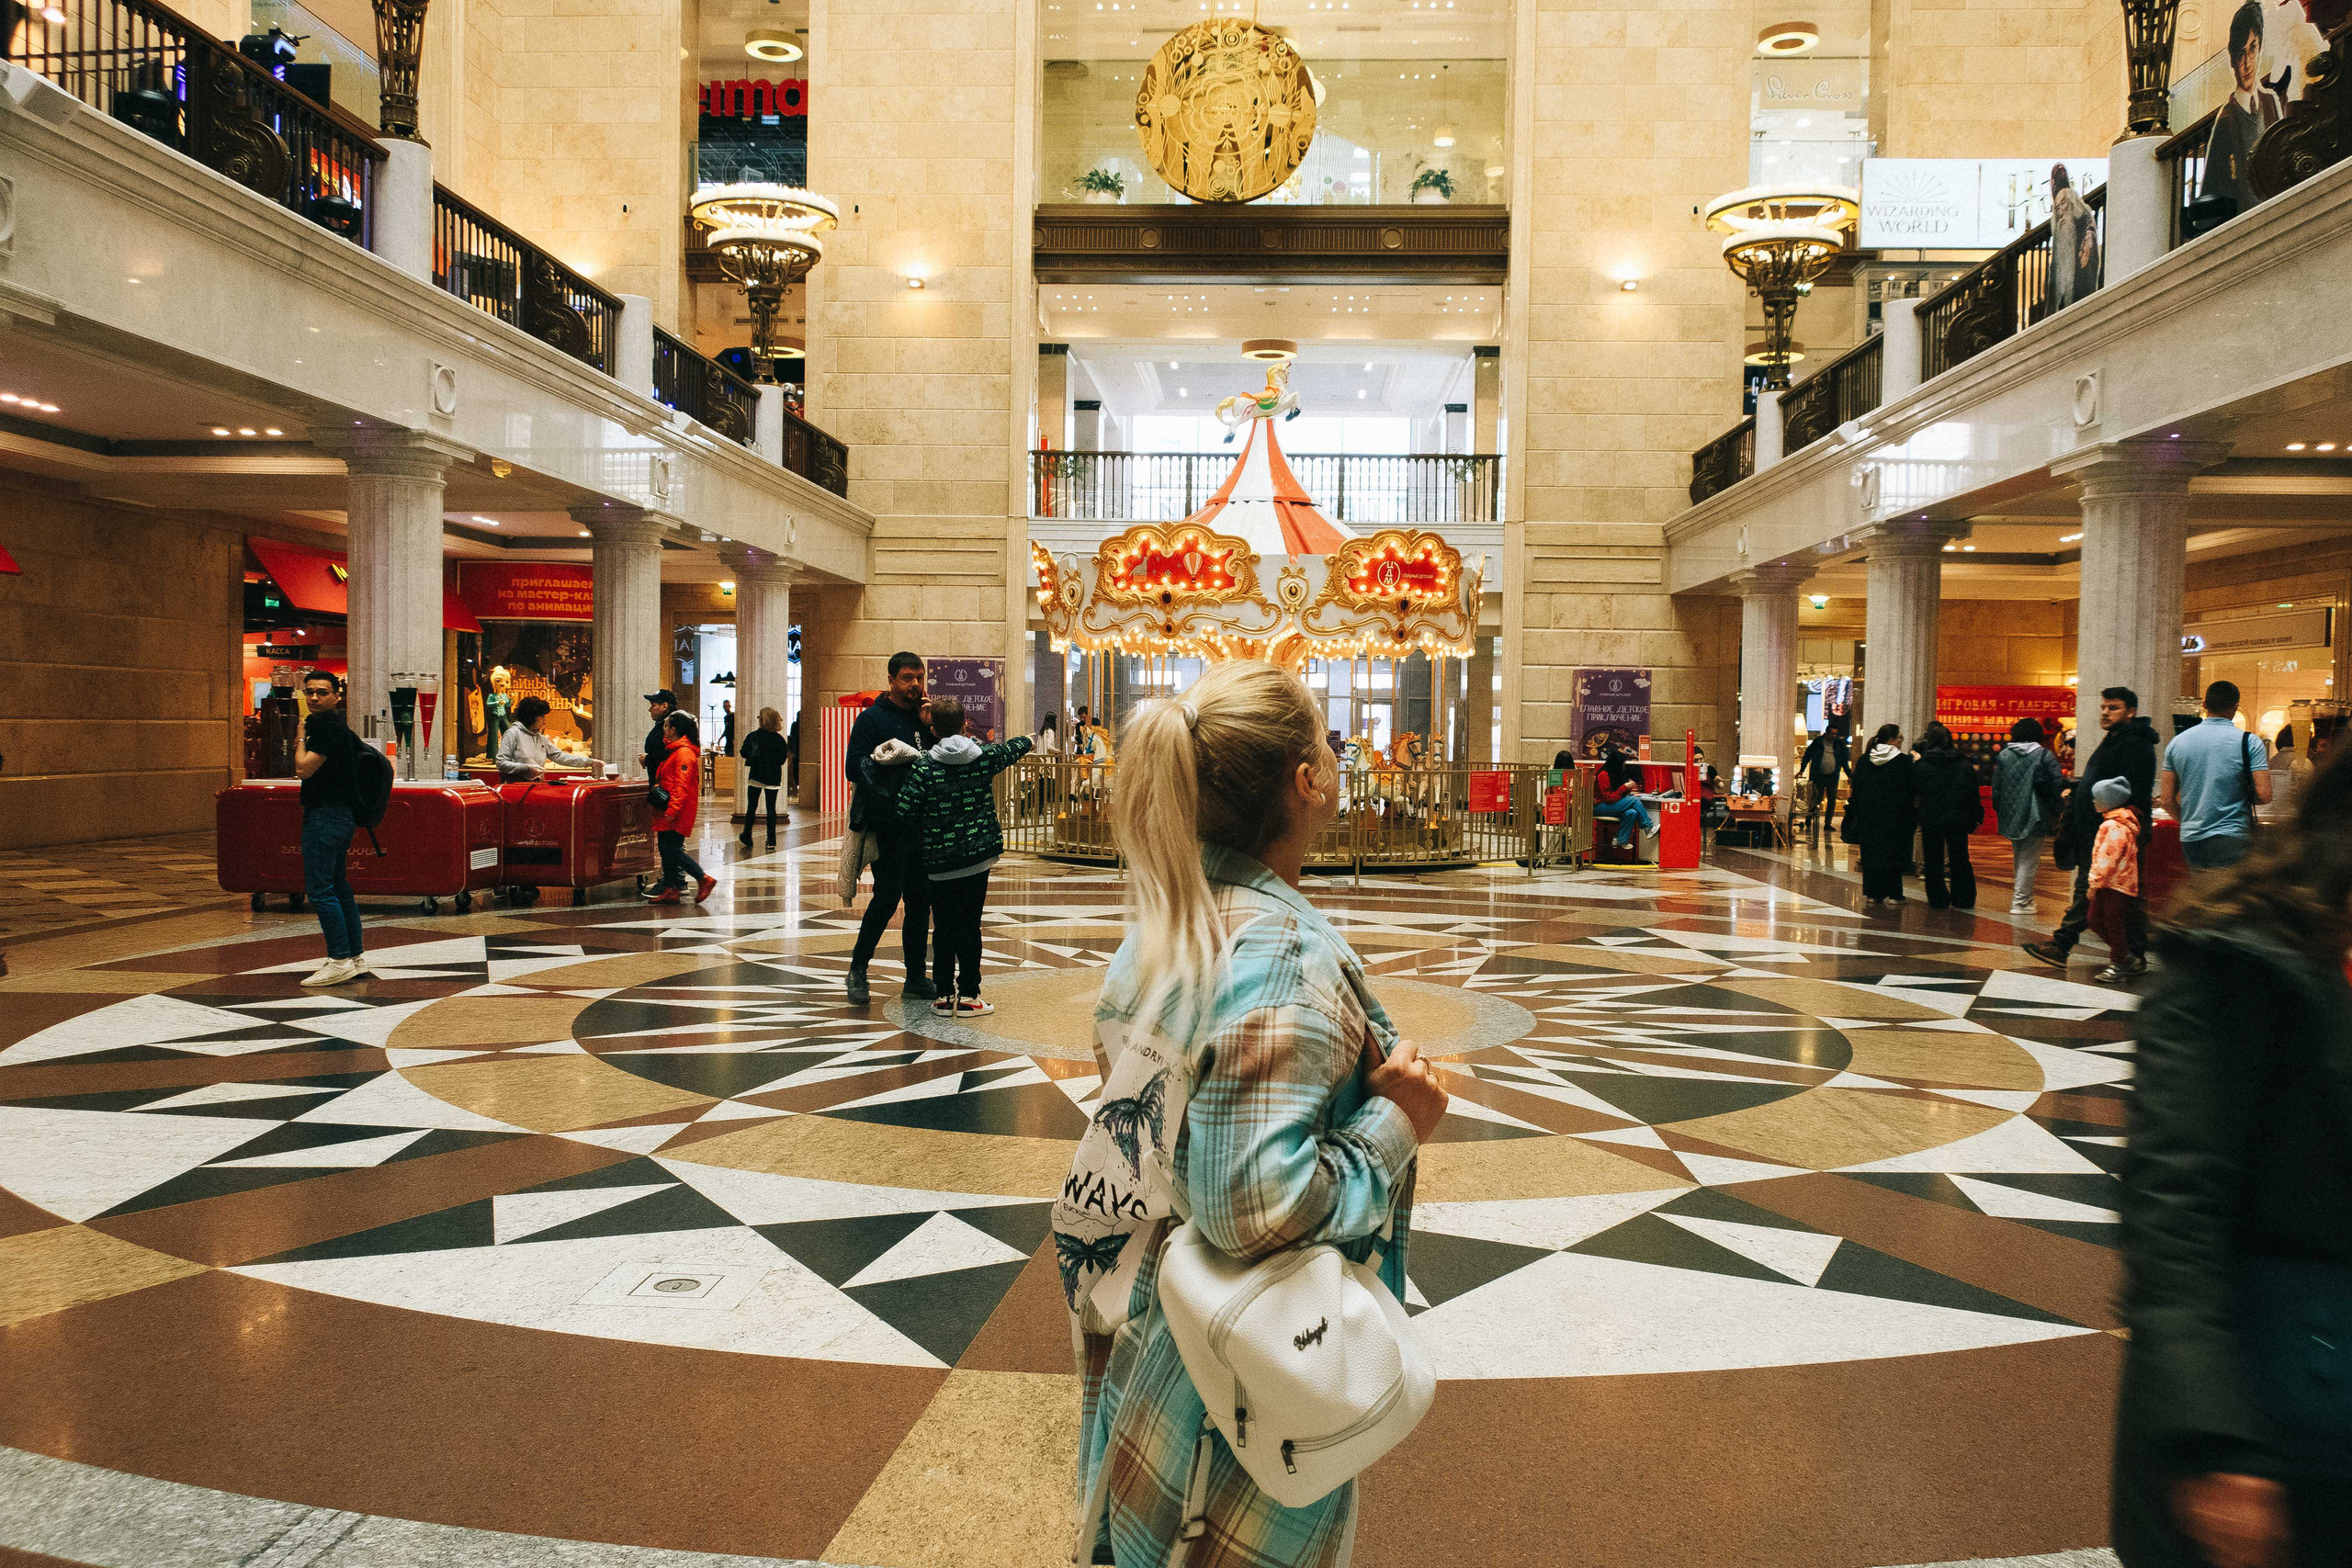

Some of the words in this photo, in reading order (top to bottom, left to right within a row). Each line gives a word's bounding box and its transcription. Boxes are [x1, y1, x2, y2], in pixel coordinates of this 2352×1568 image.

[1768, 75, 1810, 99] Silver
[1815, 80, 1853, 99] Cross
[699, 78, 808, 117] ima
[1867, 205, 1960, 219] WIZARDING
[1879, 219, 1949, 234] WORLD
[498, 590, 514, 599] на
[517, 590, 593, 602] мастер-кл
[508, 602, 526, 611] по
[527, 603, 593, 614] анимаци
[507, 675, 549, 690] айны
[963, 694, 993, 704] ДЕТСКОЕ
[963, 703, 988, 712] ЧЕНИЕ
[1580, 705, 1615, 713] ГЛАВНОЕ
[1617, 705, 1649, 714] ДЕТСКОЕ
[2007, 700, 2068, 713] ГАЛЕРЕЯ
[1587, 713, 1643, 722] ПРИКЛЮЧЕНИЕ
